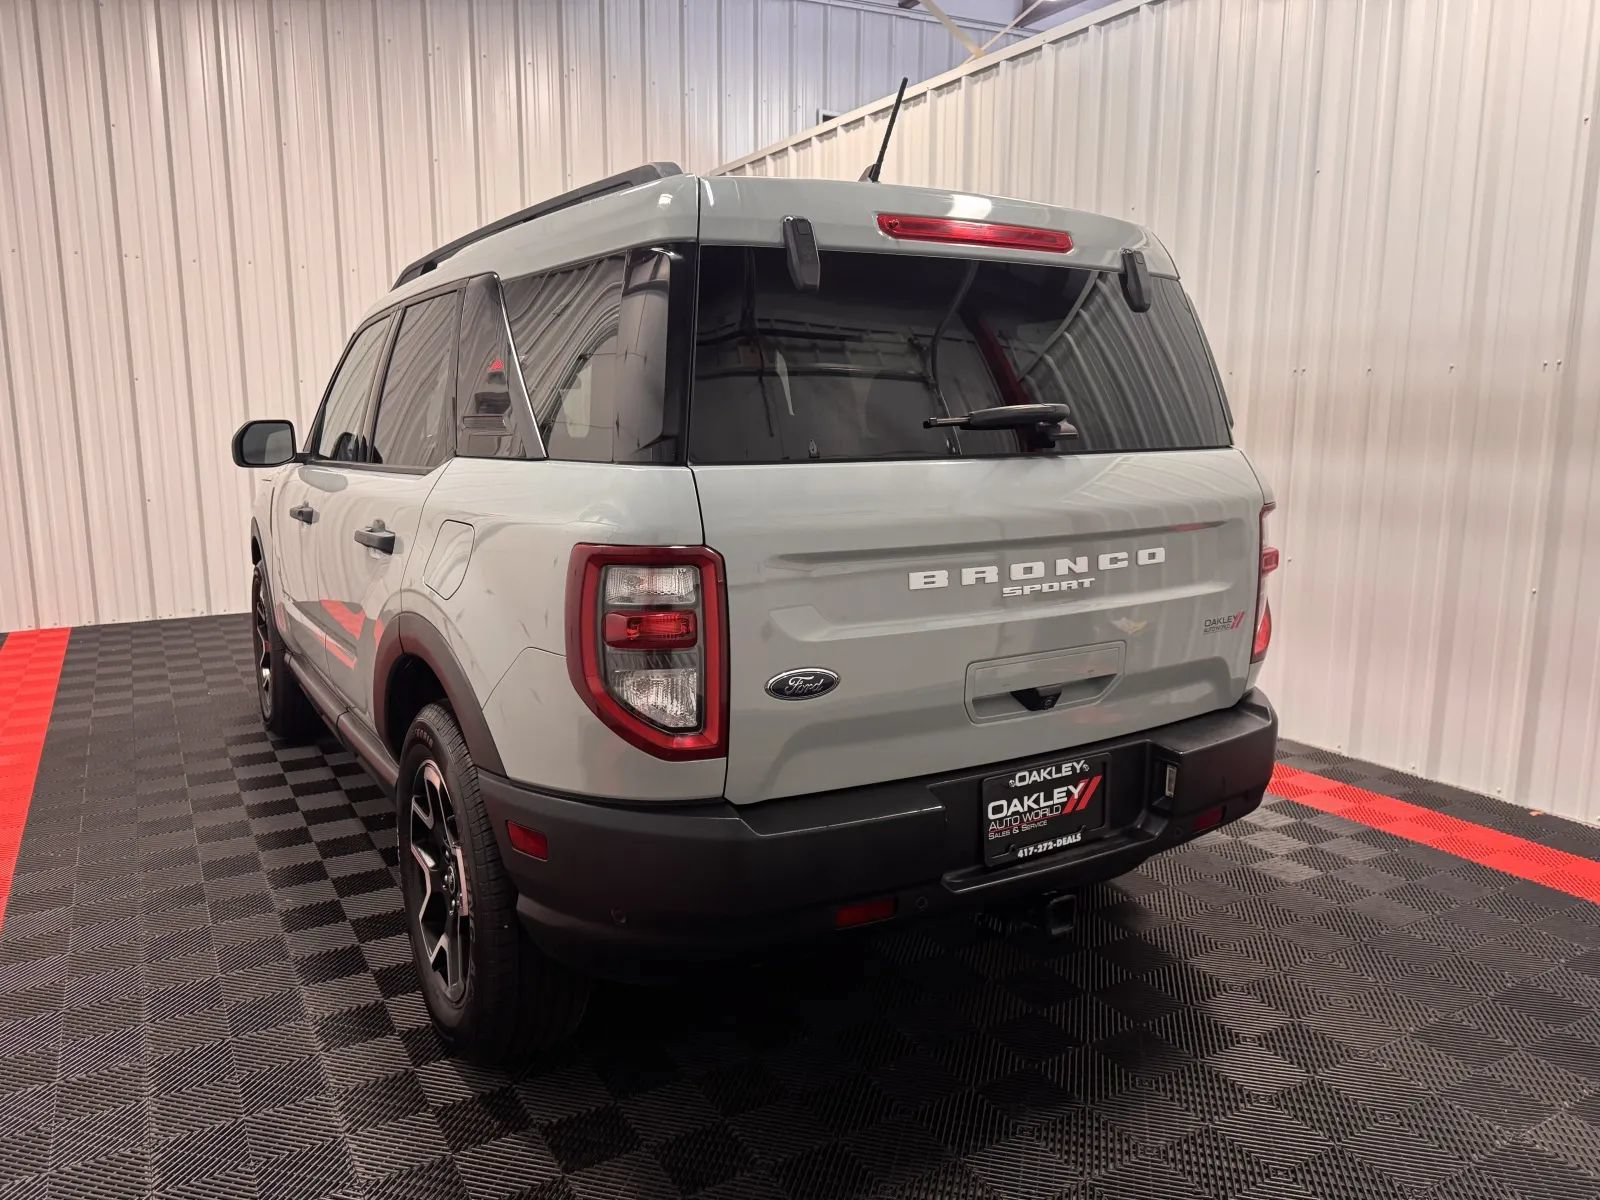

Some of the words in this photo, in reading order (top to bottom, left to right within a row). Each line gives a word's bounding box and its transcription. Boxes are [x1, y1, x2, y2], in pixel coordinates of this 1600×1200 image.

[908, 548, 1165, 590] BRONCO
[1002, 578, 1095, 597] SPORT
[1204, 614, 1238, 627] OAKLEY
[785, 676, 824, 695] Ford
[1015, 760, 1085, 787] OAKLEY
[987, 783, 1085, 820] OAKLEY
[988, 815, 1020, 831] AUTO
[1022, 805, 1061, 822] WORLD
[1012, 826, 1019, 834] &
[1017, 833, 1082, 858] 417-272-DEALS
